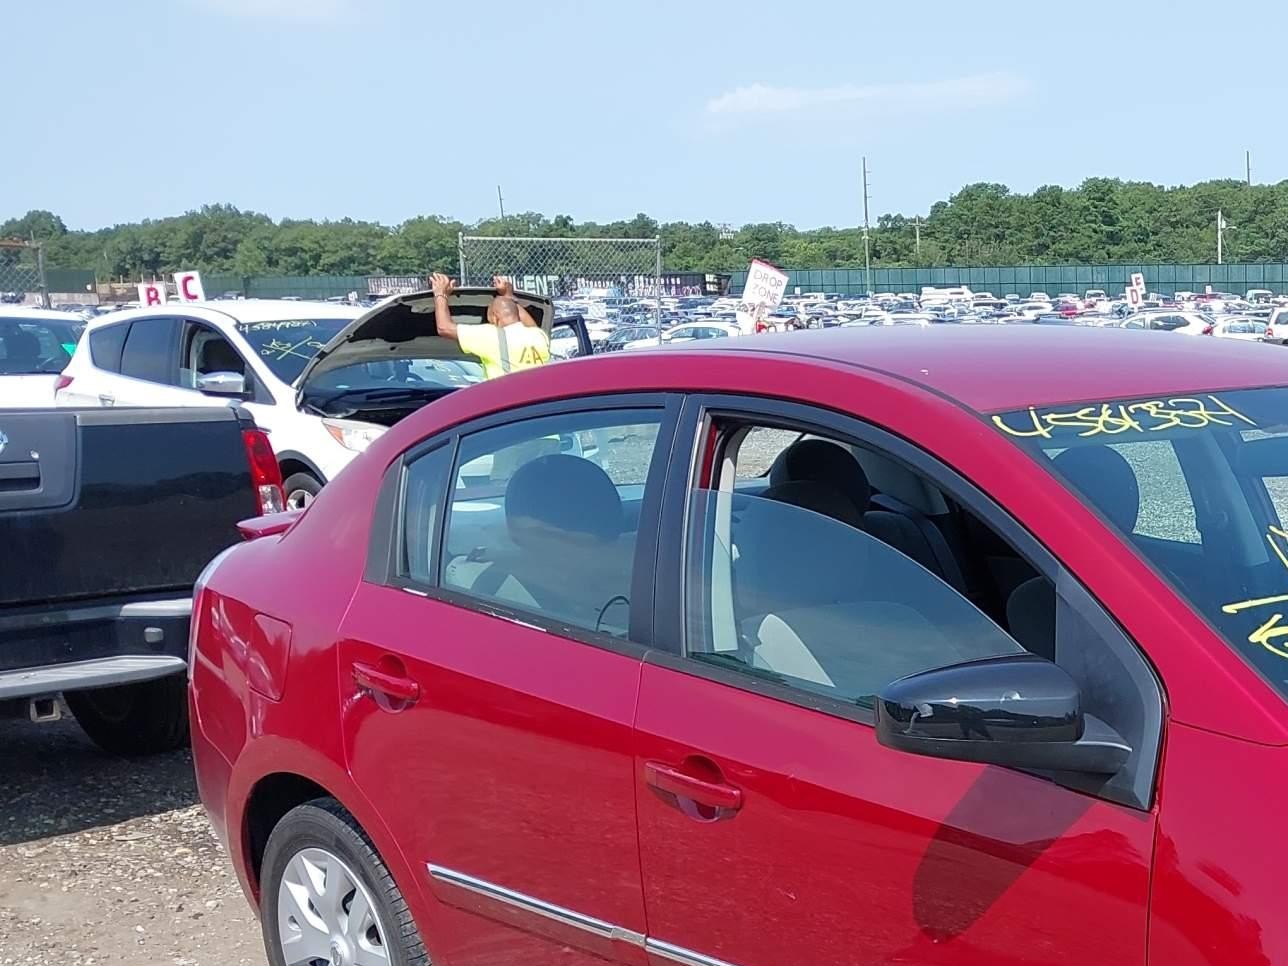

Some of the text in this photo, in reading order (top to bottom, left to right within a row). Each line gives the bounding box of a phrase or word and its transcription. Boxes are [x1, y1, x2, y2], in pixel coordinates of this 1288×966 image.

[182, 276, 198, 299] C
[753, 269, 783, 289] DROP
[752, 283, 779, 304] ZONE
[1130, 289, 1139, 304] D
